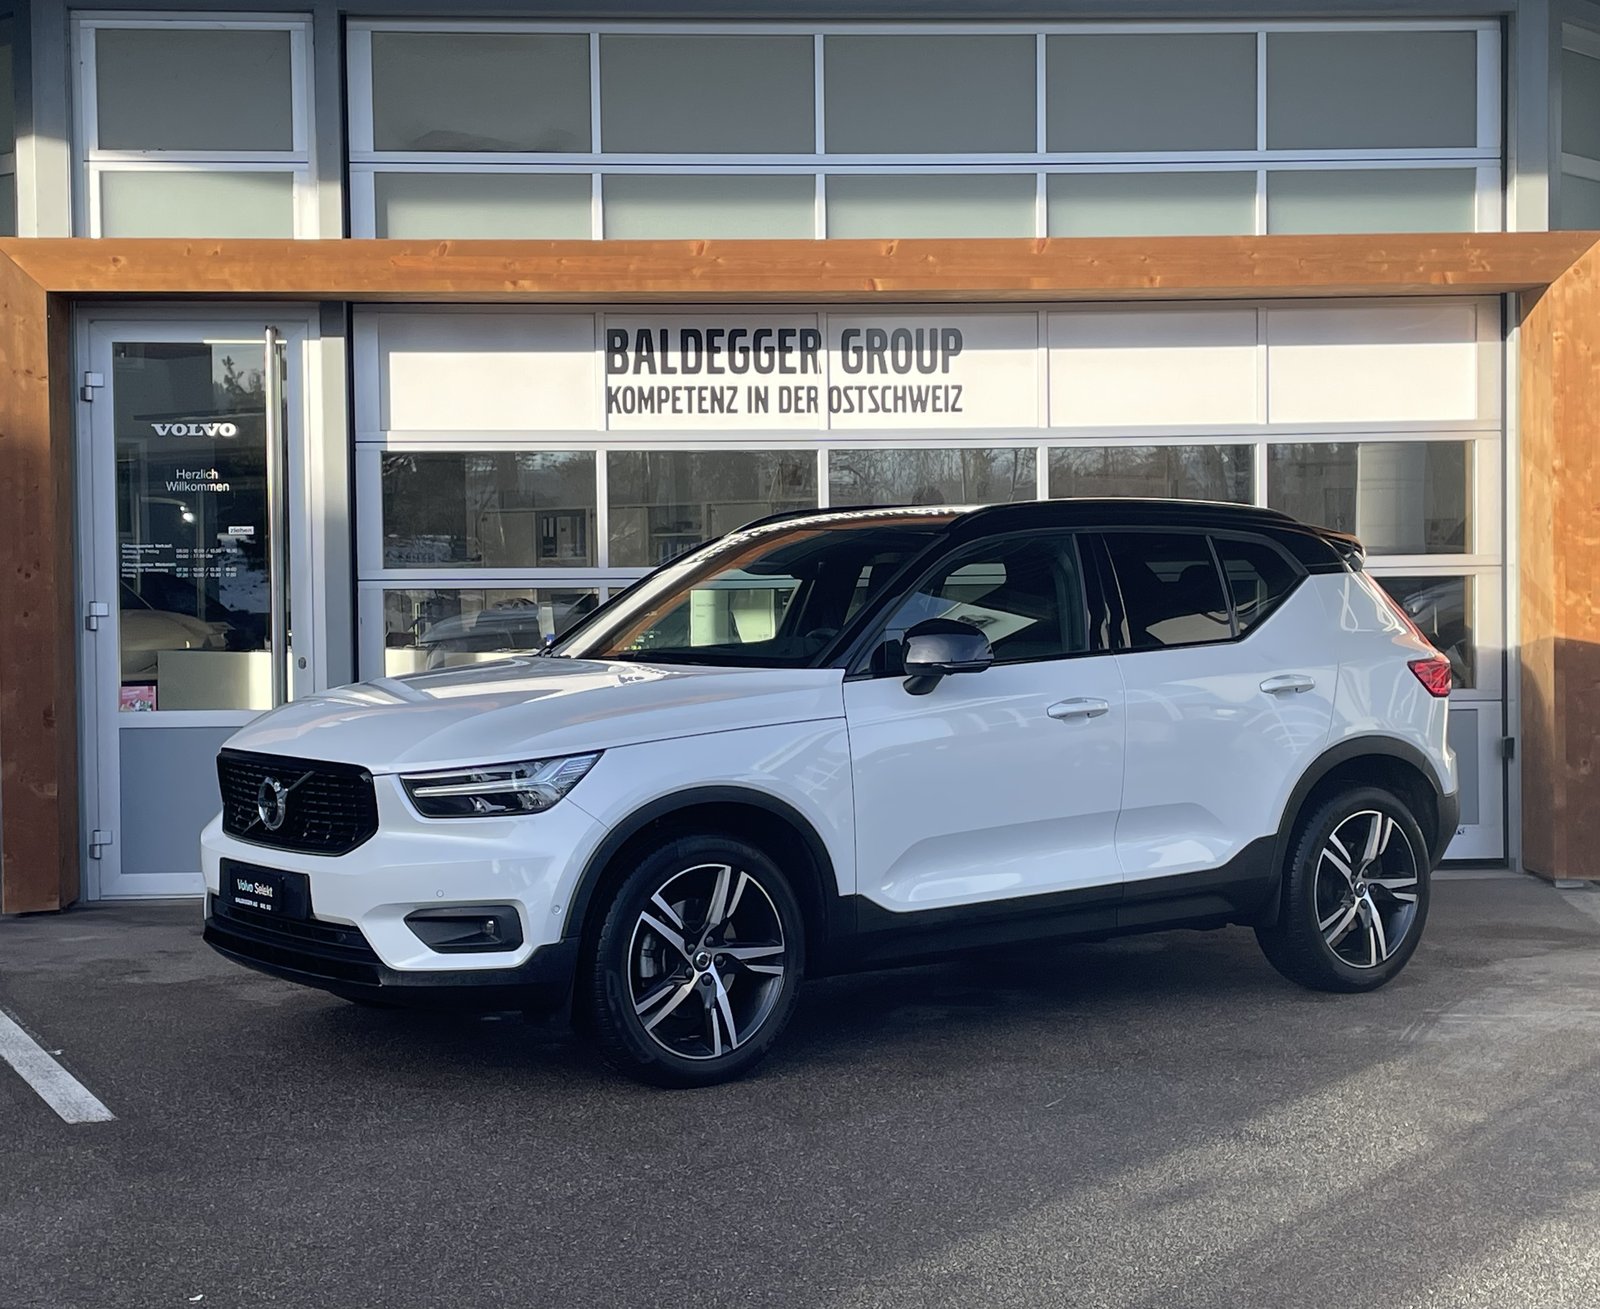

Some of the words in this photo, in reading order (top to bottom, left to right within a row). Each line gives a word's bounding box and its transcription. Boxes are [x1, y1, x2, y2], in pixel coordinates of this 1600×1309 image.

[607, 328, 822, 375] BALDEGGER
[841, 327, 963, 374] GROUP
[607, 386, 738, 414] KOMPETENZ
[747, 386, 769, 414] IN
[778, 386, 819, 414] DER
[828, 385, 963, 413] OSTSCHWEIZ
[151, 423, 237, 437] VOLVO
[176, 469, 218, 480] Herzlich
[165, 481, 230, 492] Willkommen
[236, 878, 253, 892] Volvo
[254, 882, 273, 897] Selekt
